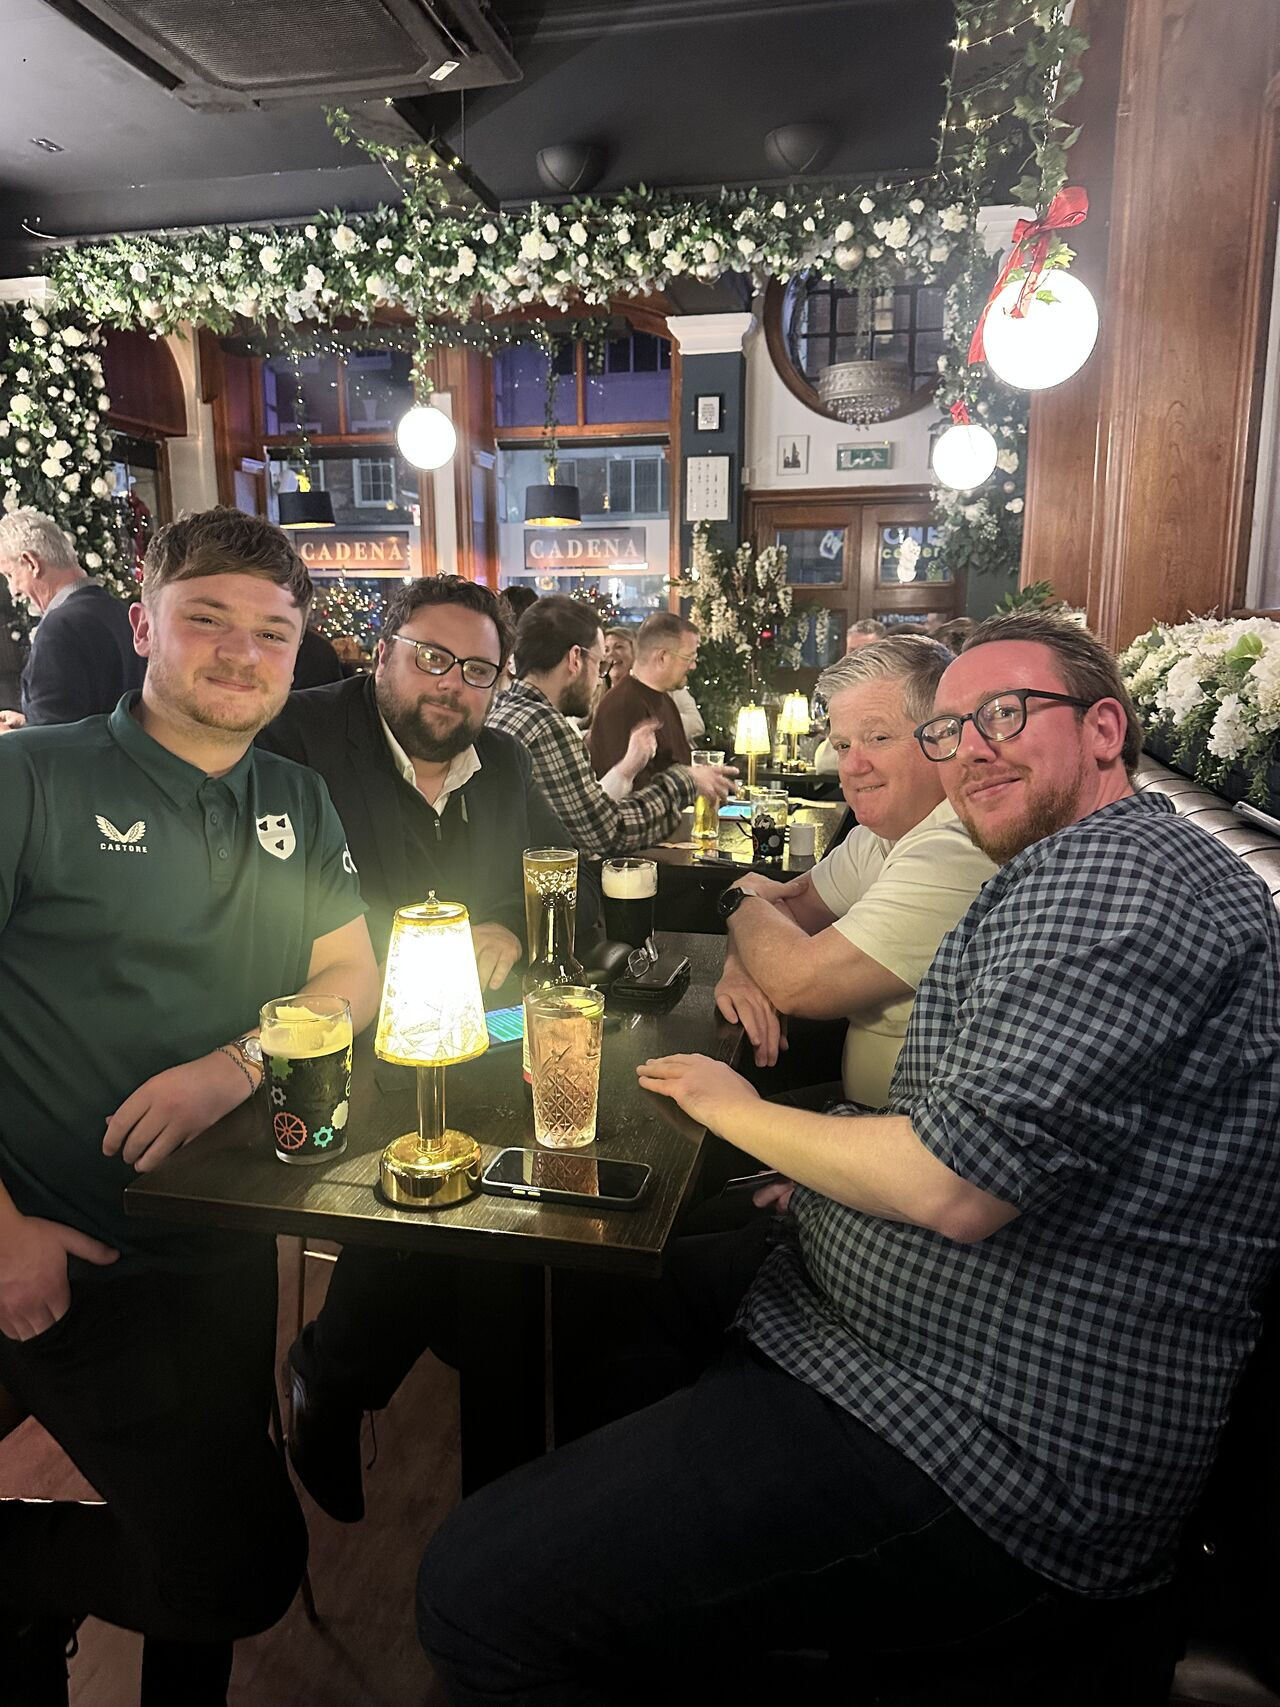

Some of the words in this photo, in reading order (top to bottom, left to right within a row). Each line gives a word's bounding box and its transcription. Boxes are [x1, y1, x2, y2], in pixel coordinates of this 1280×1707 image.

[301, 541, 403, 561] CADENA
[530, 539, 639, 559] CADENA
[100, 842, 148, 853] CASTORE
